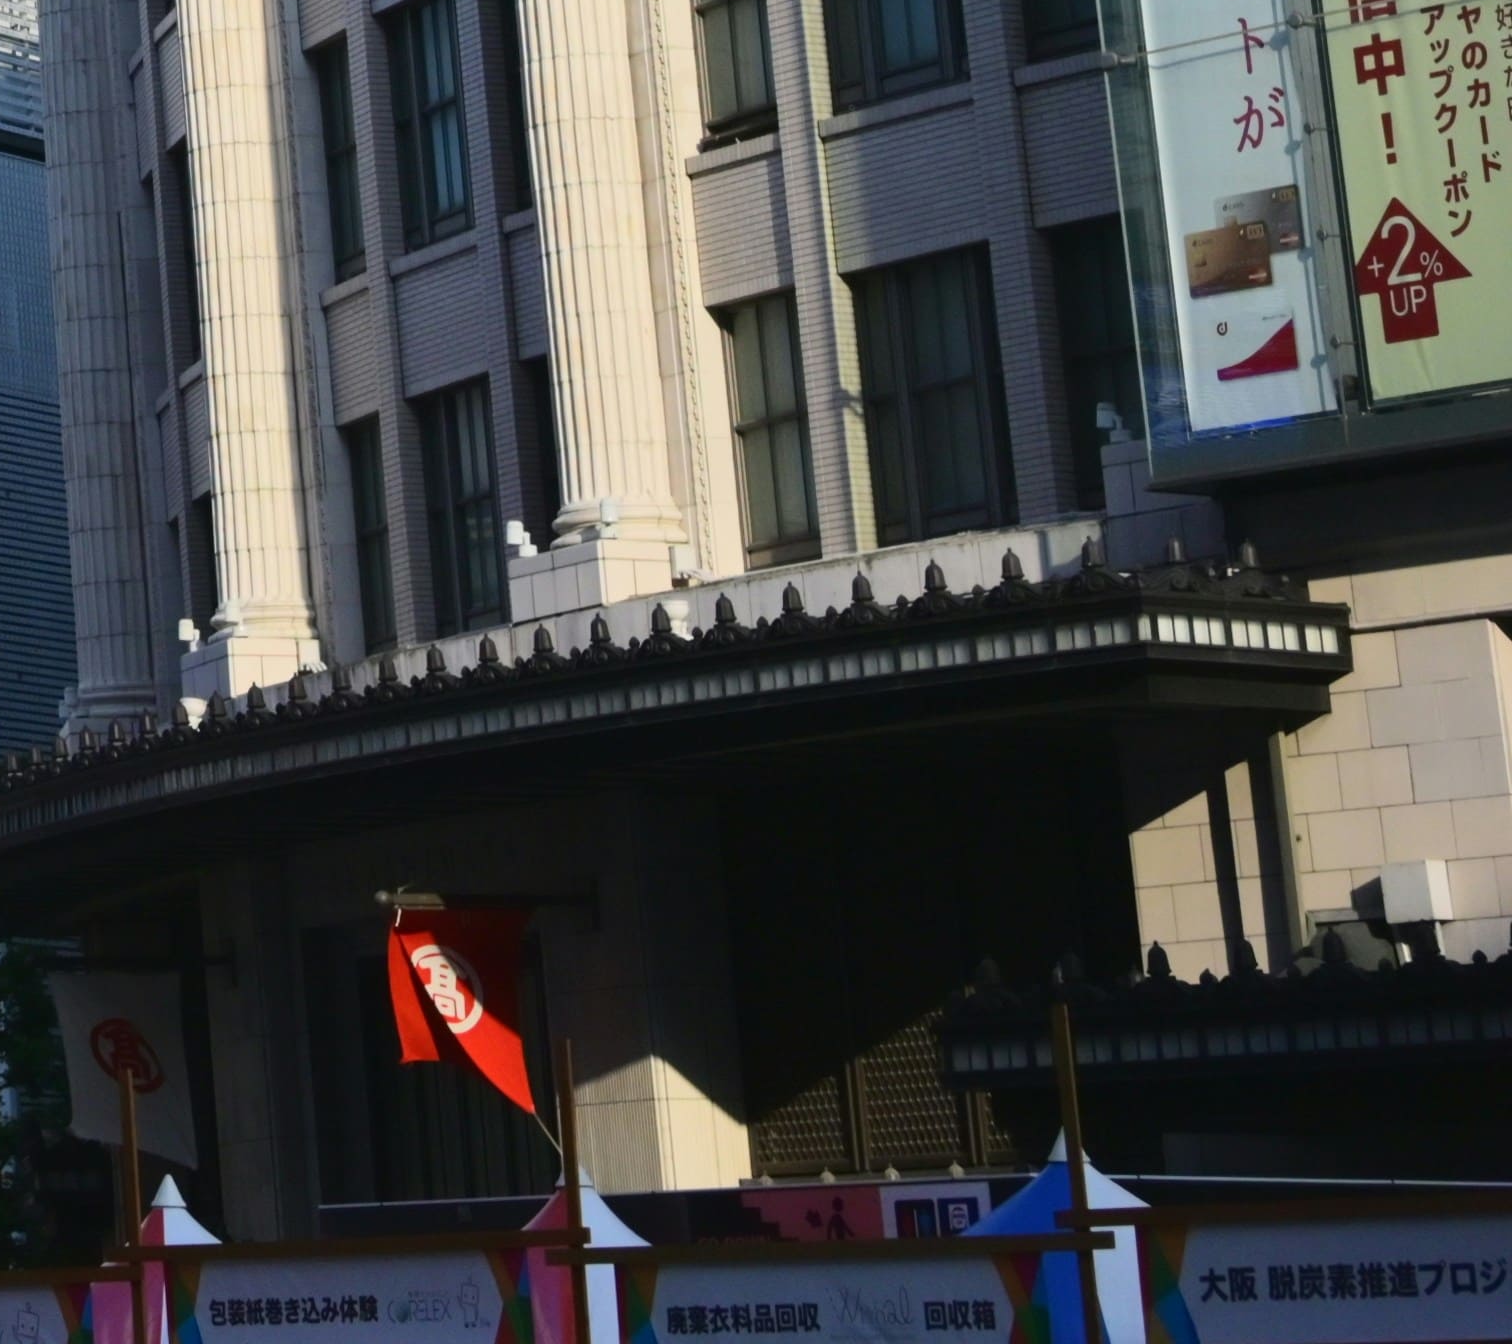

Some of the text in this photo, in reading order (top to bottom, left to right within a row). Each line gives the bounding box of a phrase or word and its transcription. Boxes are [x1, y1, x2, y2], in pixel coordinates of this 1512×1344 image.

[1390, 284, 1428, 317] UP
[1199, 1266, 1259, 1303] 大阪
[667, 1302, 822, 1335] 廃棄衣料品回収
[924, 1299, 997, 1333] 回収箱
